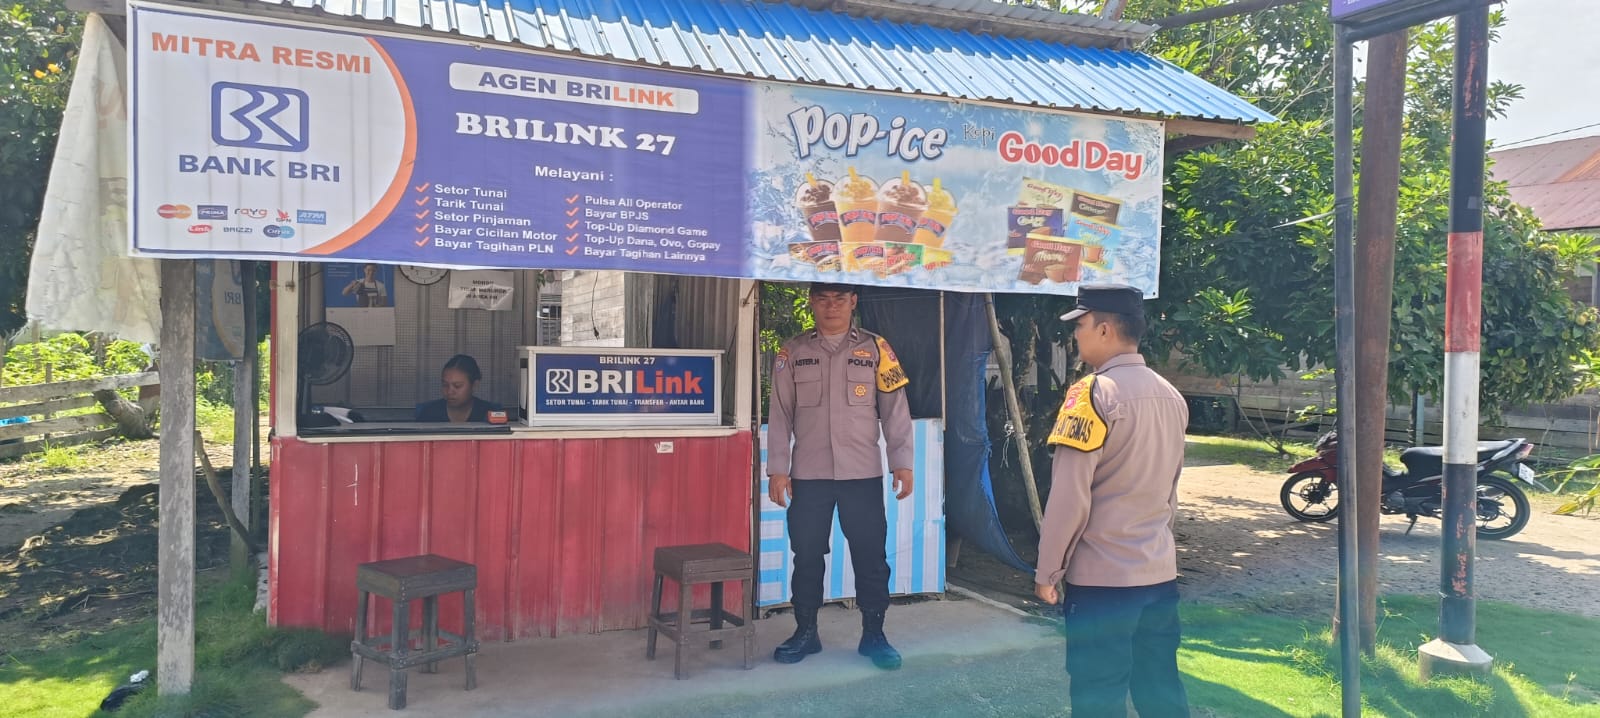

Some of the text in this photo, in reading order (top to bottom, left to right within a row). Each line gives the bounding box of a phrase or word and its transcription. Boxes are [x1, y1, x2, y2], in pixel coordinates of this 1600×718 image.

[152, 32, 371, 74] MITRA RESMI
[478, 71, 674, 107] AGEN BRILINK
[455, 112, 676, 155] BRILINK 27
[962, 123, 996, 147] Kopi
[1000, 132, 1145, 181] Good Day
[179, 154, 340, 182] BANK BRI
[535, 165, 604, 181] Melayani
[434, 184, 507, 198] Setor Tunai
[434, 197, 504, 211] Tarik Tunai
[585, 196, 683, 210] Pulsa All Operator
[434, 211, 531, 226] Setor Pinjaman
[585, 208, 649, 221] Bayar BPJS
[434, 225, 558, 241] Bayar Cicilan Motor
[585, 221, 708, 237] Top-Up Diamond Game
[434, 238, 553, 253] Bayar Tagihan PLN
[584, 234, 721, 251] Top-Up Dana, Ovo, Gopay
[584, 247, 706, 262] Bayar Tagihan Lainnya
[599, 356, 656, 365] BRILINK 27
[577, 369, 703, 395] BRILink
